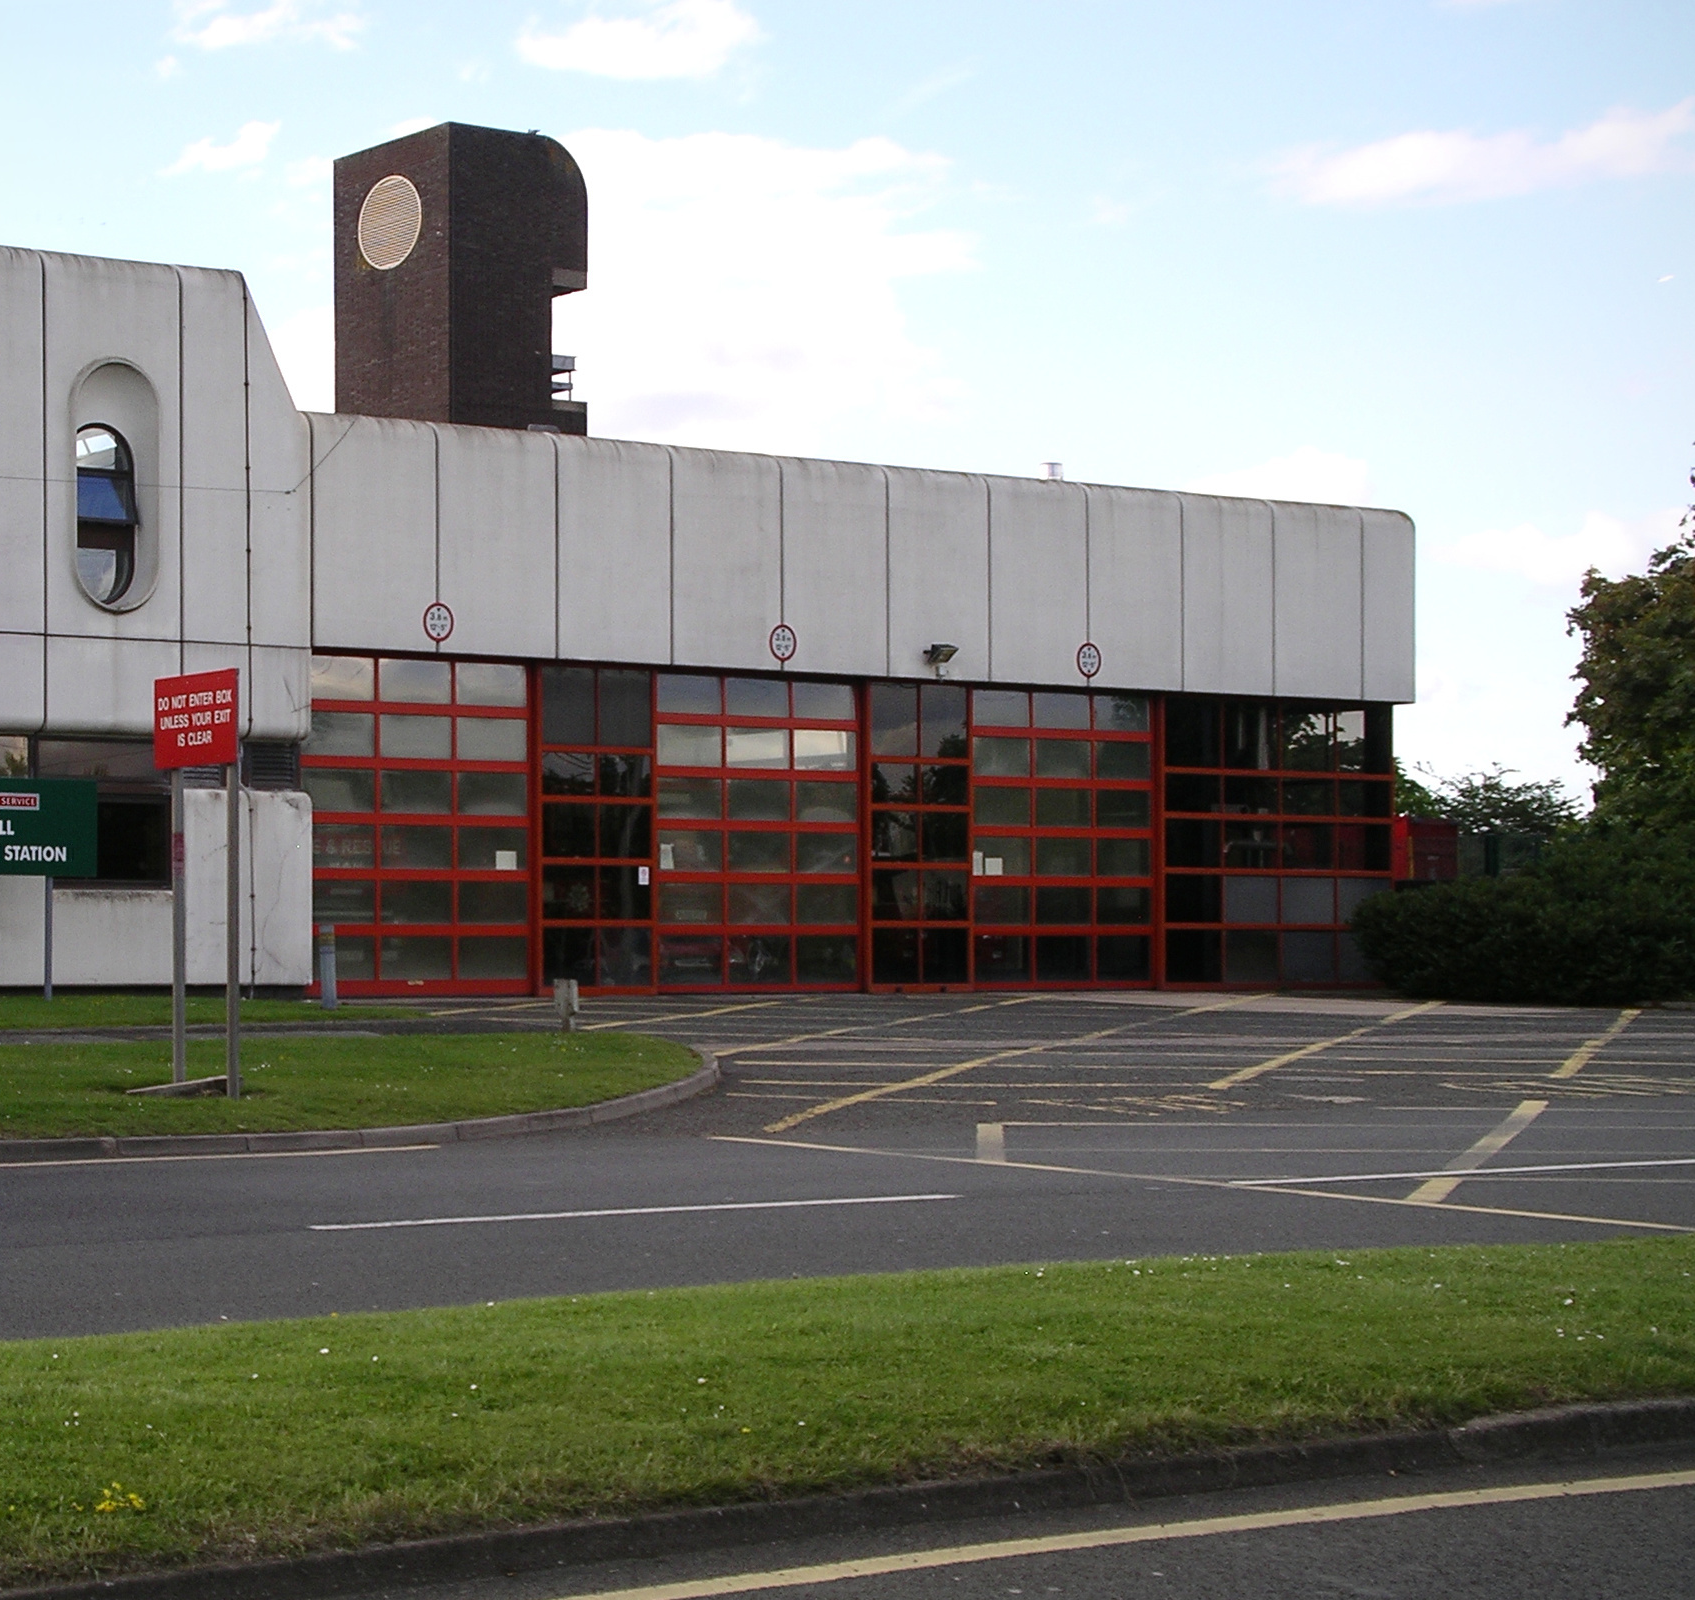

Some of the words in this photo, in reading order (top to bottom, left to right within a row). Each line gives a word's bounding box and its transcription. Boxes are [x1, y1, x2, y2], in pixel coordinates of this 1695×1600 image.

[158, 698, 169, 710] DO
[172, 695, 186, 709] NOT
[189, 692, 214, 707] ENTER
[216, 689, 232, 704] BOX
[160, 714, 189, 730] UNLESS
[192, 712, 212, 726] YOUR
[214, 709, 231, 724] EXIT
[177, 733, 186, 747] IS
[188, 730, 212, 746] CLEAR
[1, 797, 36, 806] SERVICE
[4, 846, 67, 862] STATION
[342, 839, 401, 854] RESUE
